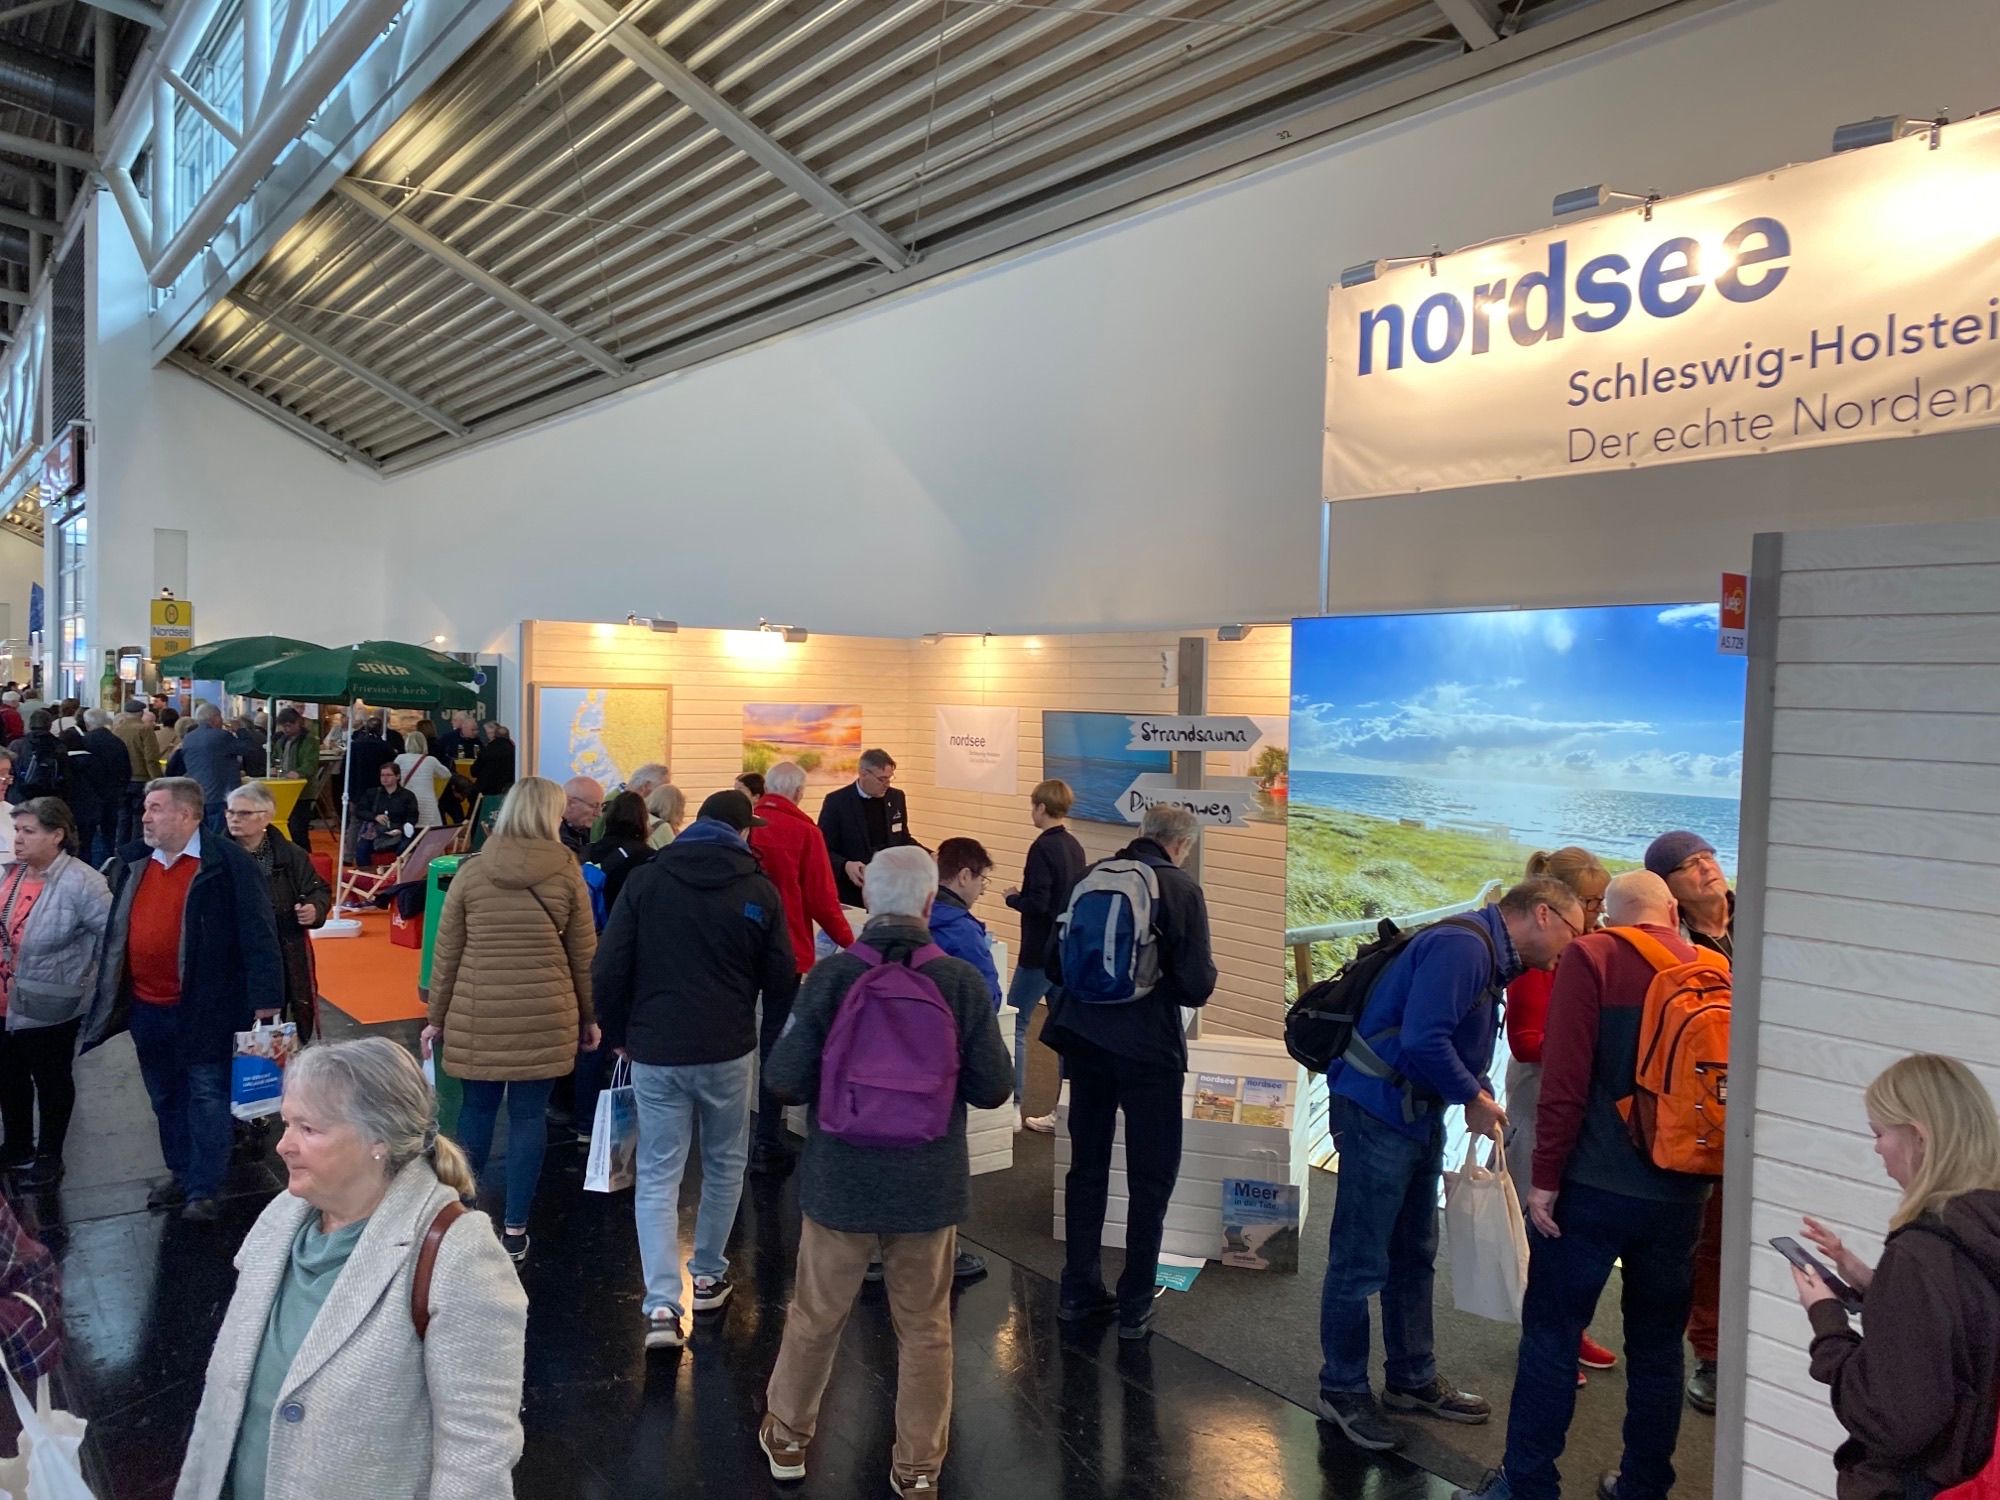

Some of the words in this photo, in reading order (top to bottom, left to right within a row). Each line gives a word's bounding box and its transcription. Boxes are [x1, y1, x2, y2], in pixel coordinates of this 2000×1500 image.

[1358, 216, 1791, 376] nordsee
[1568, 427, 1640, 463] Der
[1653, 407, 1774, 453] echte
[1793, 376, 1992, 435] Norden
[152, 626, 190, 636] Nordsee
[357, 662, 411, 676] JEVER
[1141, 721, 1248, 742] Strandsauna
[949, 733, 986, 747] nordsee
[1200, 1074, 1236, 1085] nordsee
[1247, 1078, 1283, 1089] nordsee
[1234, 1182, 1280, 1201] Meer
